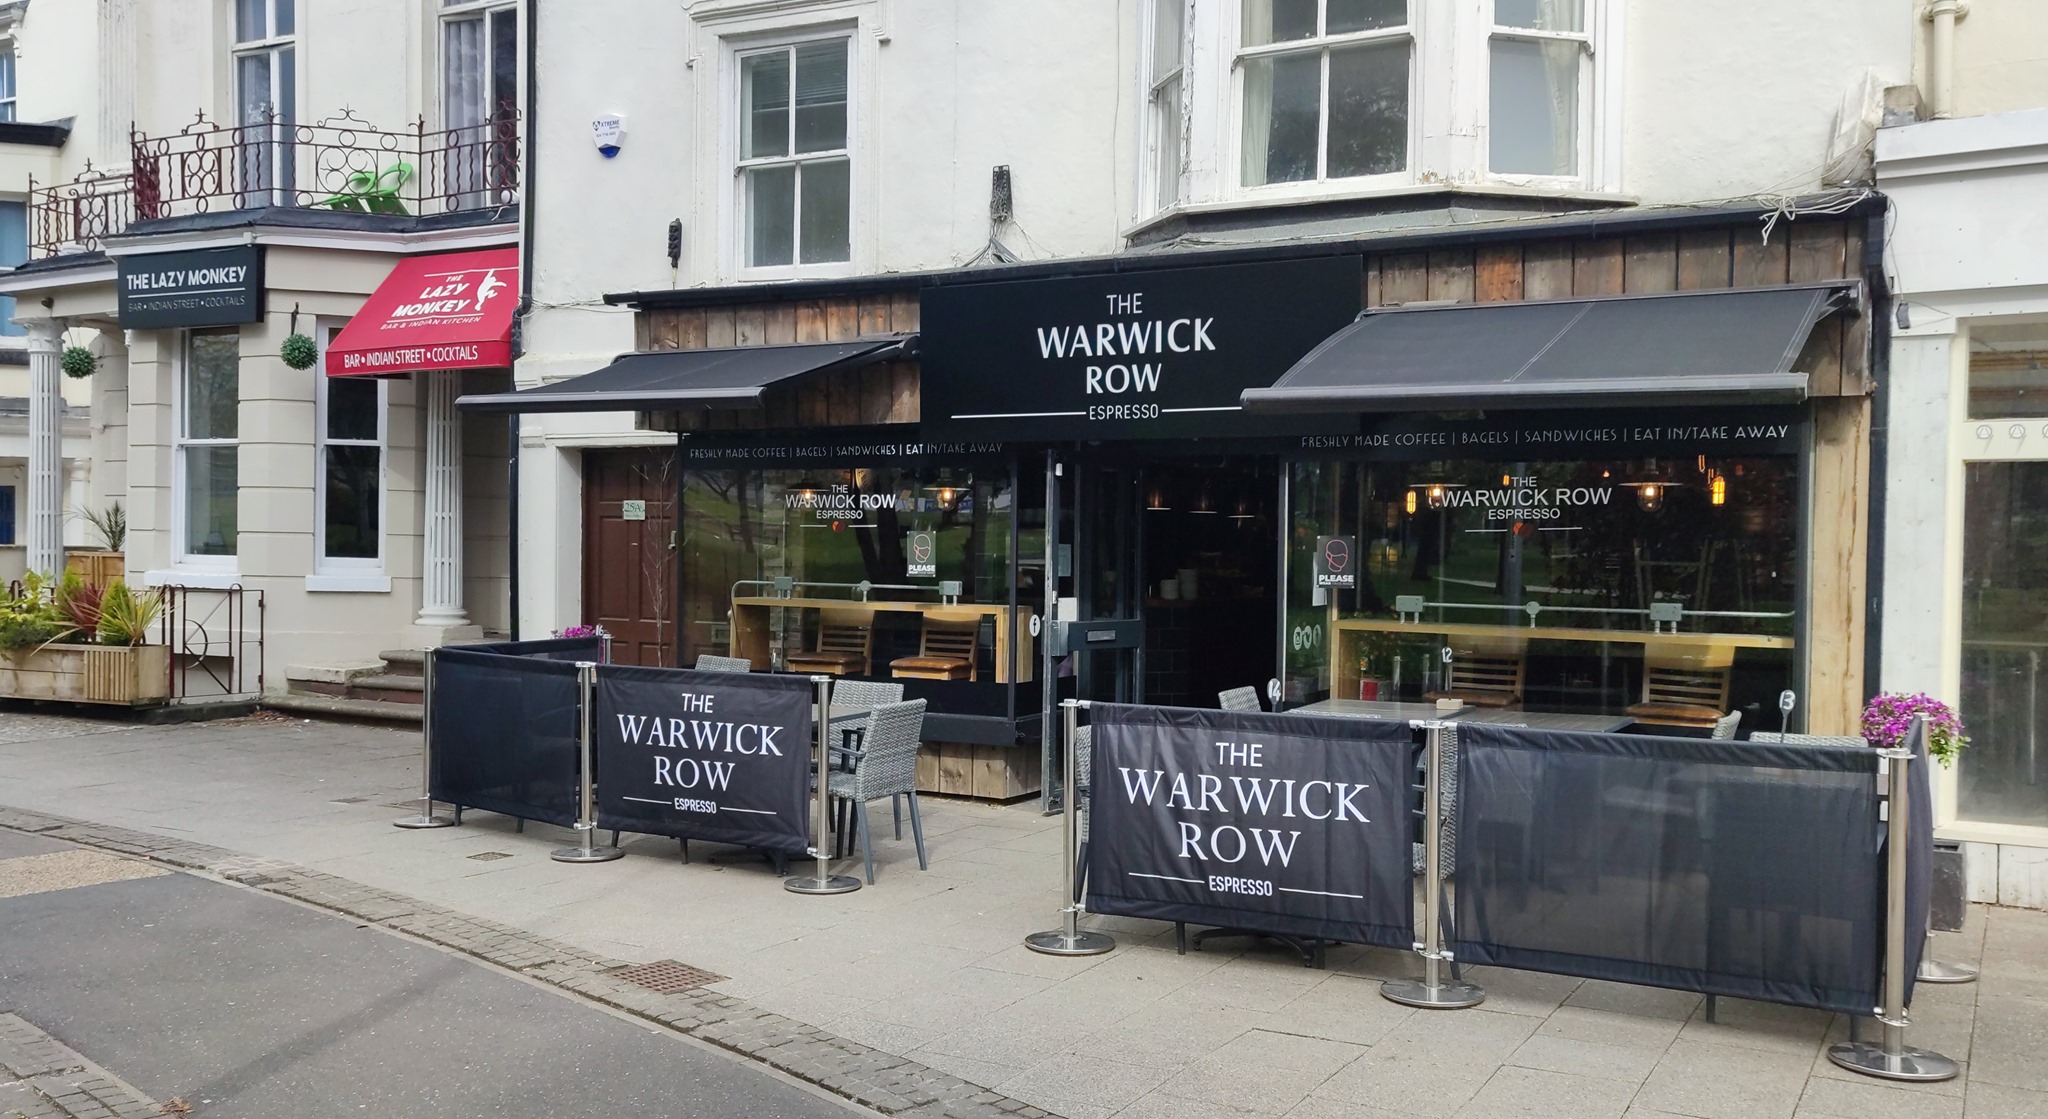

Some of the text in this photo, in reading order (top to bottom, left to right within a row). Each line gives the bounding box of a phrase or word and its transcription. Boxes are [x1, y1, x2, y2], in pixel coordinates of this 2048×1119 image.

[601, 119, 620, 127] XTREME
[127, 266, 247, 290] THE LAZY MONKEY
[446, 274, 464, 282] THE
[419, 283, 470, 299] LAZY
[128, 295, 245, 312] BAR INDIAN STREET COCKTAILS
[391, 299, 471, 317] MONKEY
[1106, 292, 1143, 315] THE
[408, 319, 440, 327] INDIAN
[442, 316, 481, 325] KITCHEN
[1037, 317, 1216, 359] WARWICK
[344, 345, 478, 368] BAR INDIAN STREET COCKTAILS
[1086, 363, 1162, 394] ROW
[1089, 404, 1159, 420] ESPRESSO
[1301, 424, 1789, 448] FRESHLY MADE COFFEE BAGELS SANDWICHES EAT IN/TAKE AWAY
[690, 443, 1003, 458] FRESHLY MADE COFFEE BAGELS SANDWICHES EAT IN/TAKE AWAY
[831, 484, 848, 493] THE
[1511, 476, 1537, 487] THE
[785, 493, 896, 508] WARWICK ROW
[1440, 487, 1612, 507] WARWICK ROW
[816, 509, 864, 519] ESPRESSO
[1488, 508, 1560, 520] ESPRESSO
[908, 564, 935, 572] PLEASE
[1319, 574, 1354, 582] PLEASE
[1442, 647, 1452, 663] 12
[1268, 680, 1281, 702] 14
[682, 693, 714, 714] THE
[1779, 691, 1795, 710] 13
[616, 713, 784, 756] WARWICK
[1215, 742, 1263, 767] THE
[653, 755, 736, 792] ROW
[1118, 767, 1370, 823] WARWICK
[674, 797, 716, 814] ESPRESSO
[1178, 821, 1301, 868] ROW
[1208, 875, 1273, 897] ESPRESSO
